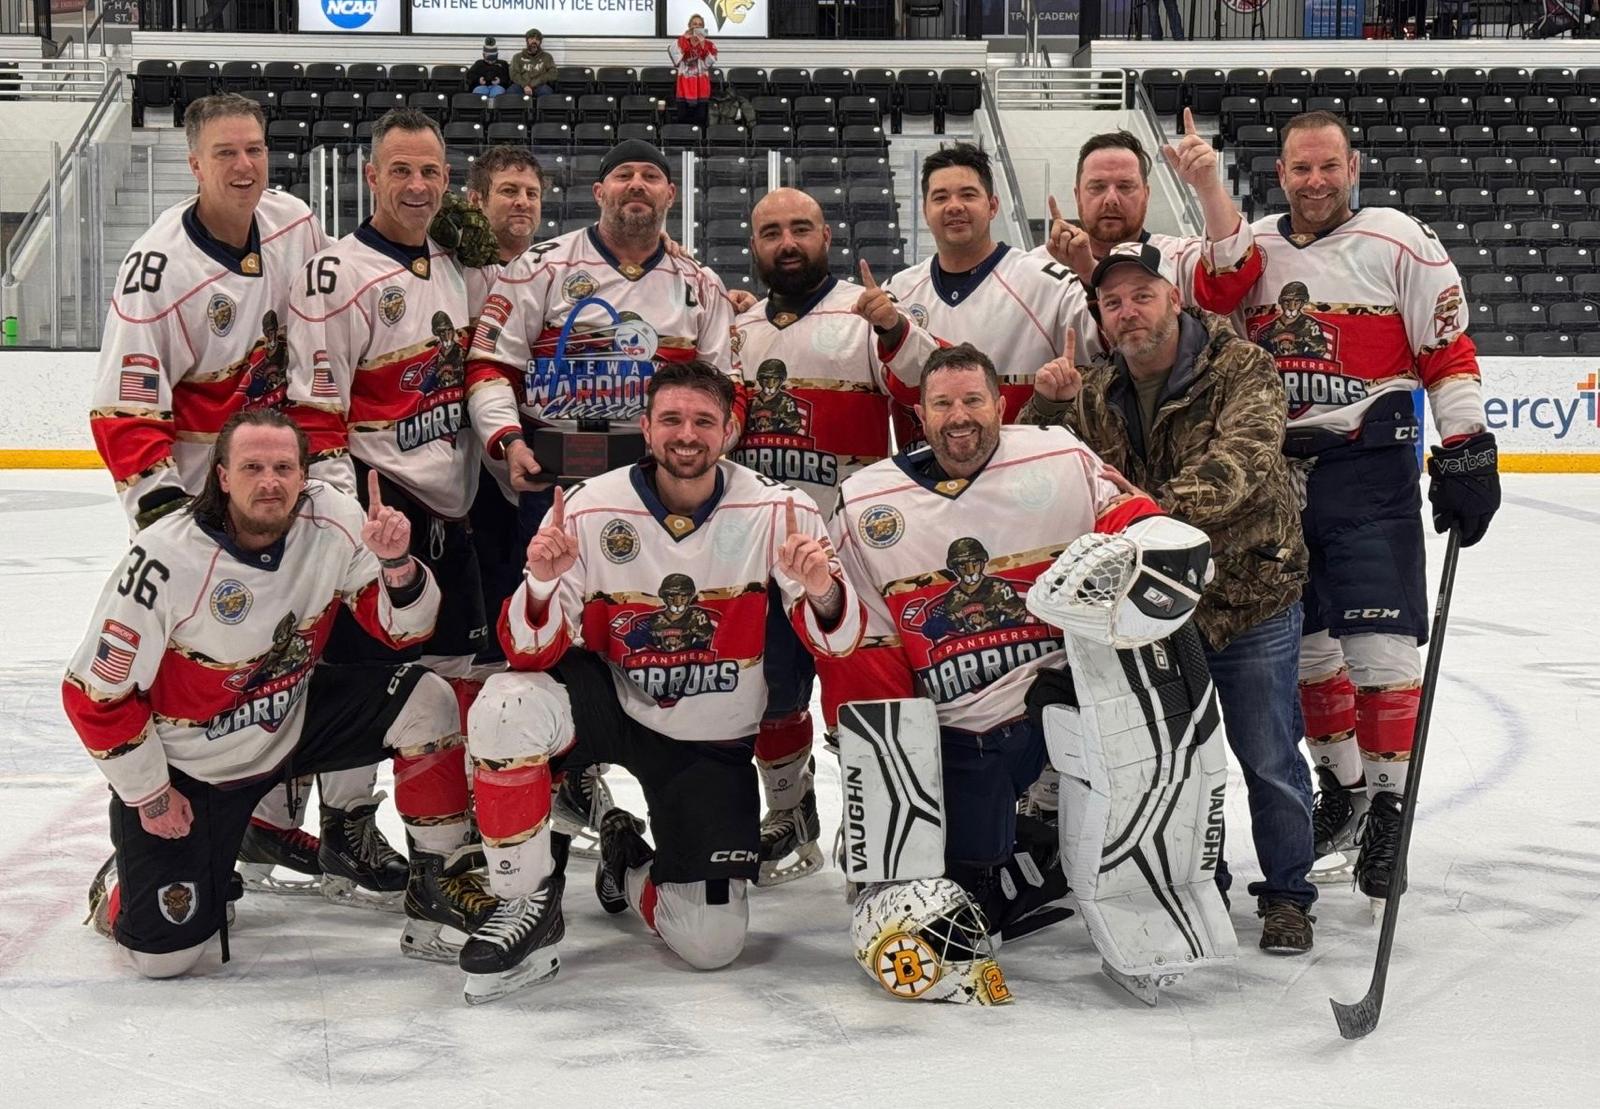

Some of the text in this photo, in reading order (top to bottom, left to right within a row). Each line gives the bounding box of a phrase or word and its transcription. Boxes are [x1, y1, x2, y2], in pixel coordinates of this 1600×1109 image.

[327, 0, 374, 15] NCAA
[412, 0, 654, 12] CENTENE COMMUNITY ICE CENTER
[1032, 12, 1079, 20] CADEMY
[122, 251, 168, 295] 28
[305, 256, 341, 297] 16
[527, 361, 661, 375] GATEWAY
[1276, 361, 1325, 370] NTHERS
[525, 374, 652, 407] WARRIO
[1284, 372, 1367, 404] RIORS
[540, 395, 645, 419] Classic
[1484, 397, 1581, 439] ercy
[400, 402, 462, 449] WARR
[1394, 426, 1418, 440] CC
[746, 437, 798, 446] ANTHERS
[733, 448, 837, 486] RRIORS
[118, 545, 170, 610] 36
[1001, 586, 1014, 600] 22
[1344, 608, 1400, 620] CCM
[469, 626, 488, 639] CC
[946, 630, 1029, 654] PANTHERS
[847, 766, 867, 873] VAUGHN
[1200, 783, 1226, 870] VAUGHN
[710, 850, 759, 863] CCM
[894, 948, 924, 985] B
